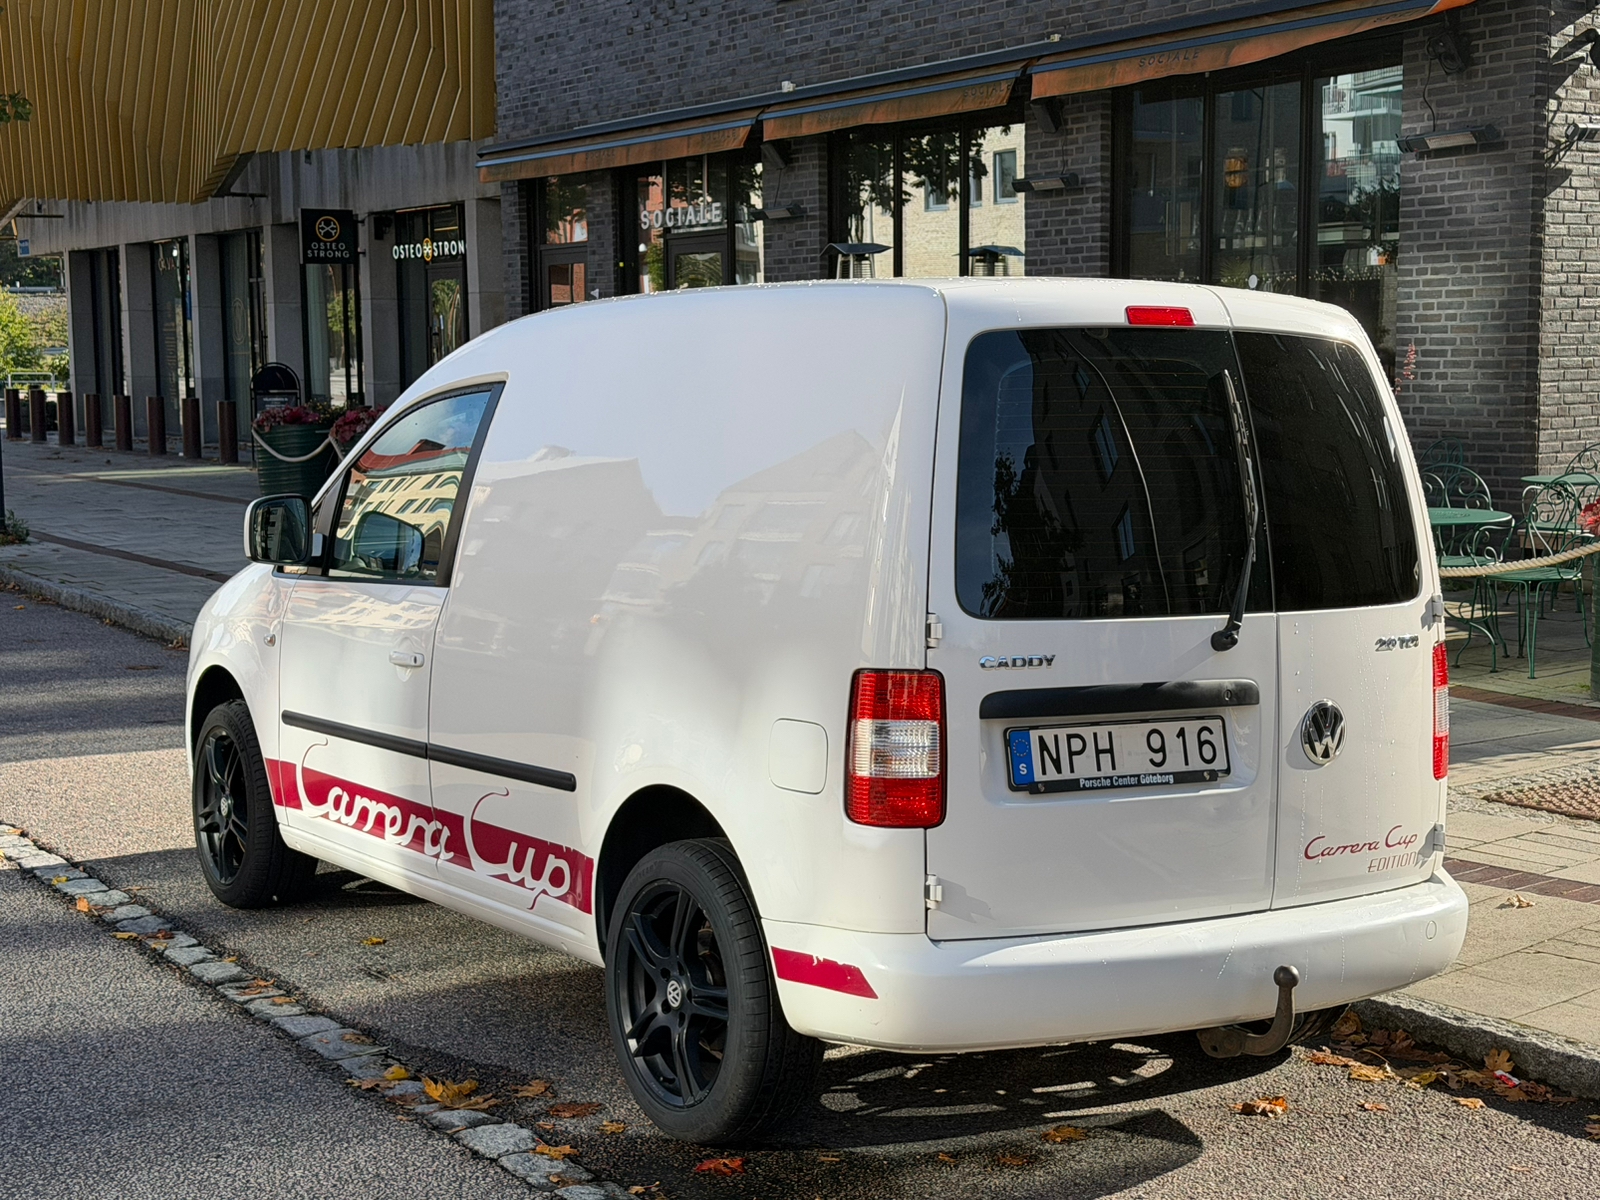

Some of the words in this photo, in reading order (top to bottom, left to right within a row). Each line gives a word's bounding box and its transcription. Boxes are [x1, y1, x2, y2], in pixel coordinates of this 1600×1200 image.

[1139, 48, 1200, 67] SOCIALE
[640, 202, 722, 230] SOCIALE
[307, 250, 350, 258] STRONG
[311, 242, 346, 250] OSTEO
[392, 243, 422, 260] OSTEO
[433, 240, 467, 256] STRON
[979, 654, 1056, 671] CADDY
[1019, 763, 1028, 775] S
[1038, 730, 1117, 776] NPH
[1146, 725, 1218, 768] 916
[1079, 776, 1111, 788] Porsche
[1112, 775, 1138, 787] Center
[1140, 773, 1174, 786] Göteborg
[296, 737, 455, 860] Carrera
[463, 786, 571, 911] Cup
[1304, 835, 1380, 860] Carrera
[1384, 825, 1418, 850] Cup
[1367, 851, 1417, 873] EDITION
